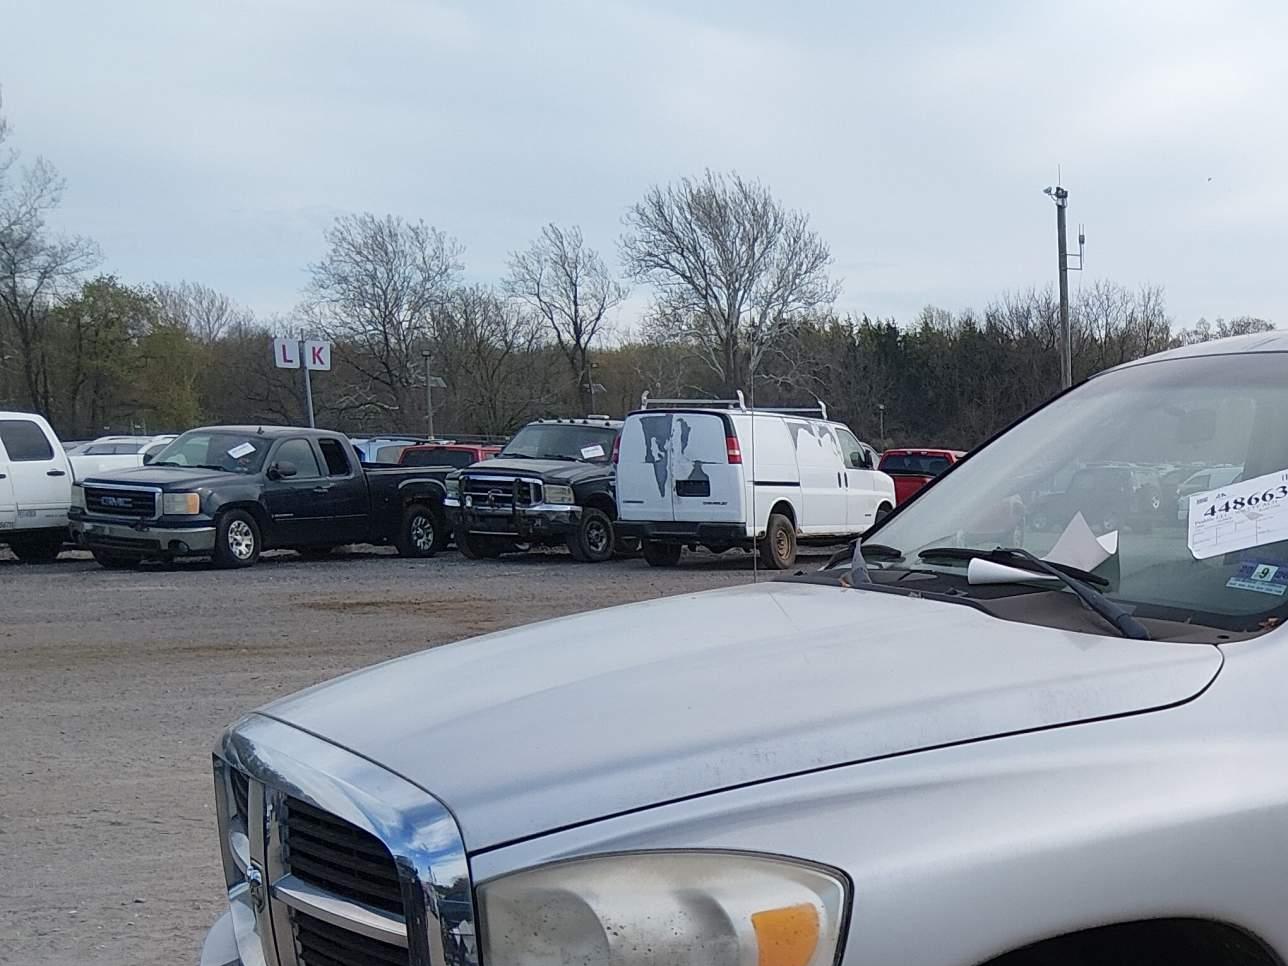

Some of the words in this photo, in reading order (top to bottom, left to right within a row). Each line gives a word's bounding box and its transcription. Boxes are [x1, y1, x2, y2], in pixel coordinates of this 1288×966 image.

[282, 345, 293, 363] L
[312, 346, 325, 365] K
[101, 496, 133, 508] GMC
[1259, 567, 1270, 579] 9
